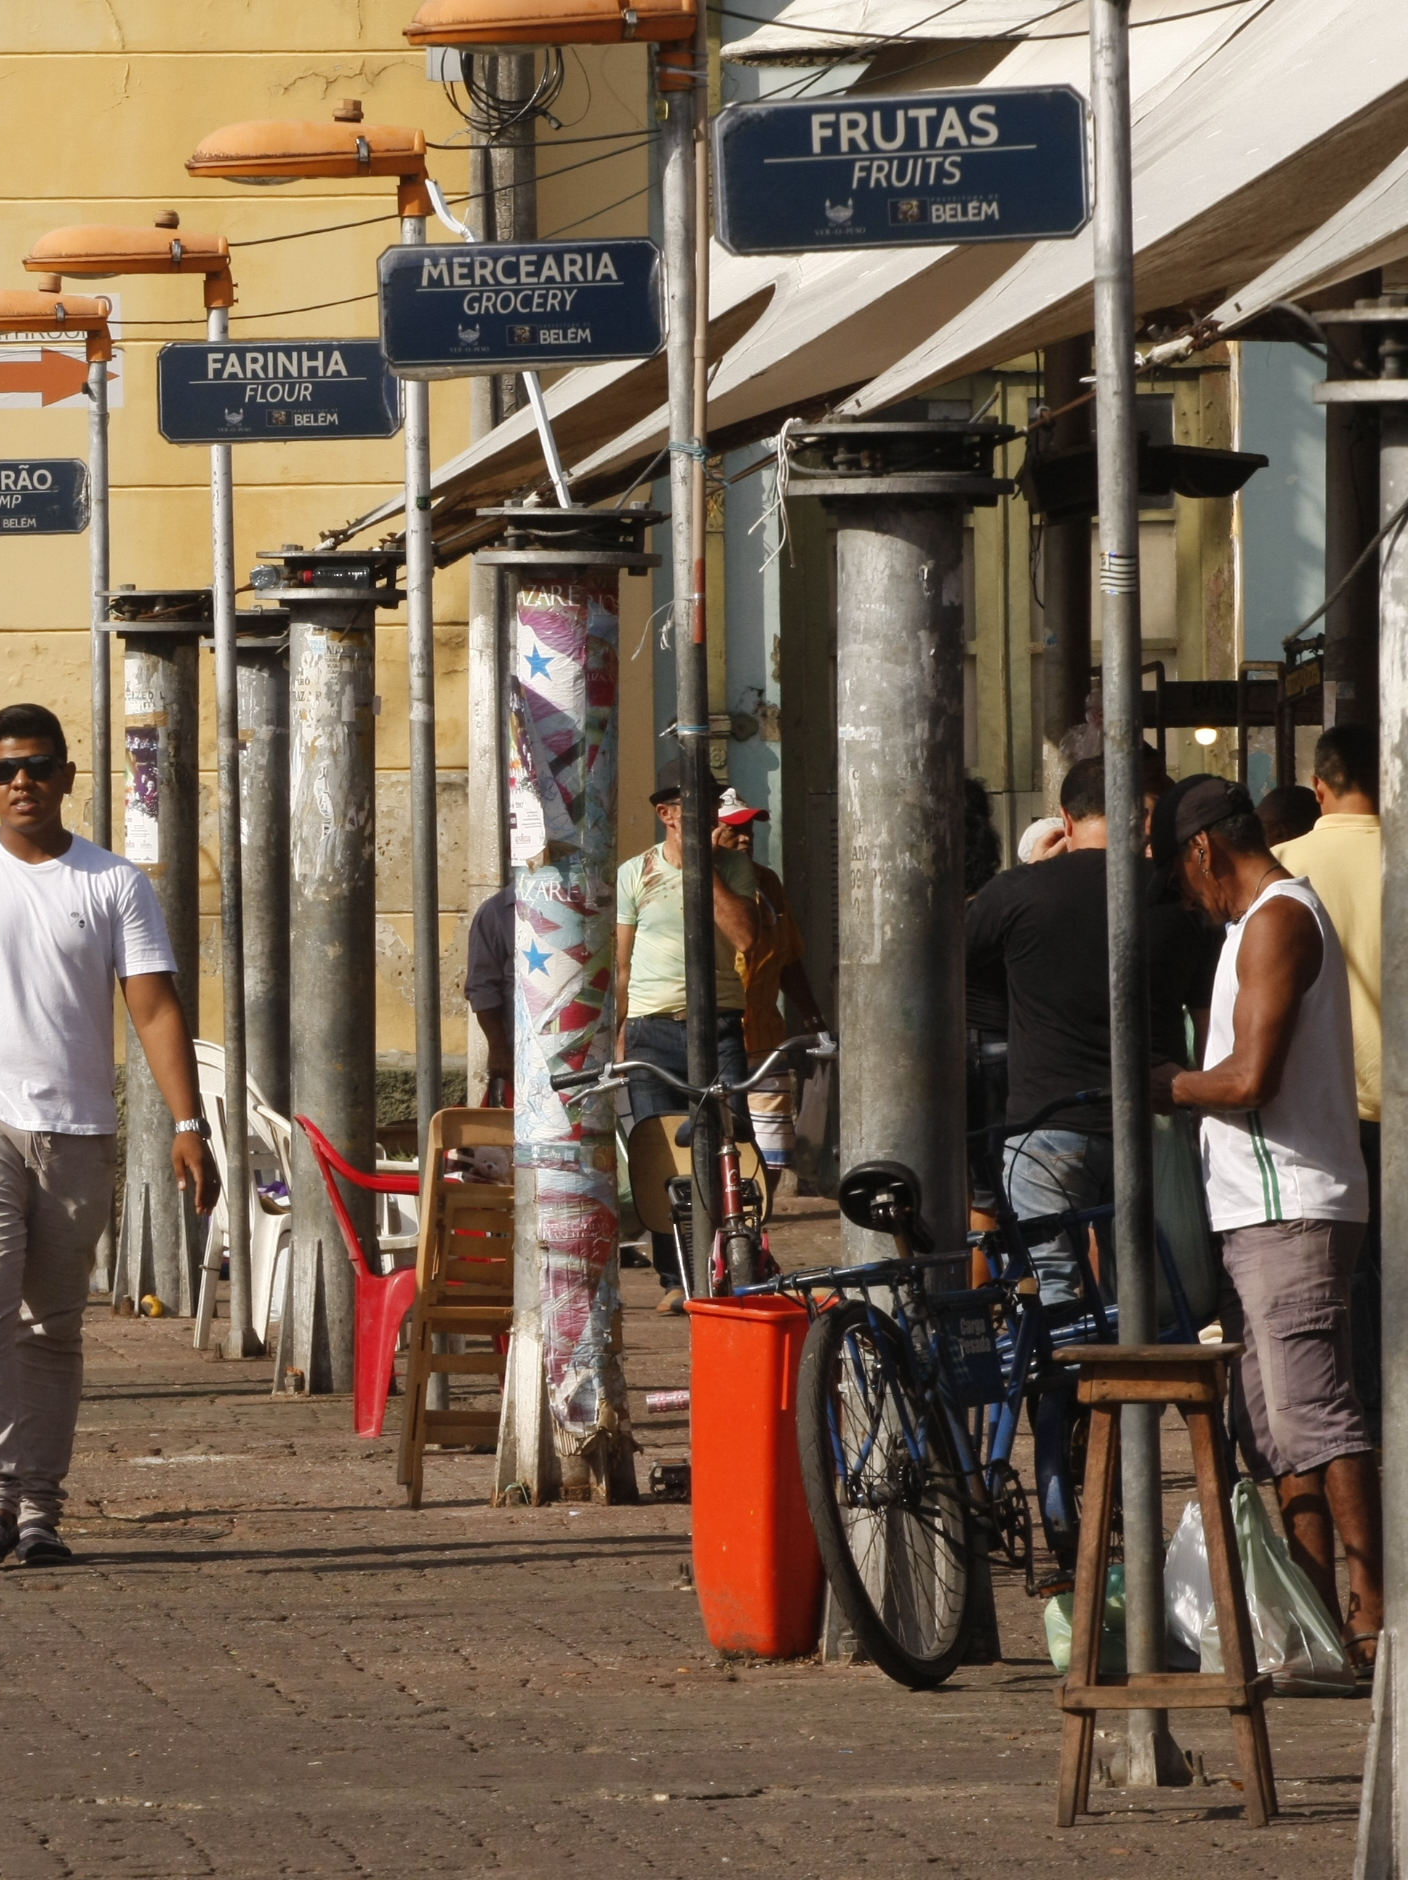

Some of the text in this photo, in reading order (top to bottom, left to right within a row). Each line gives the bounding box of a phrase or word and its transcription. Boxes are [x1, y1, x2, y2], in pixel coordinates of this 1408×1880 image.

[810, 105, 999, 154] FRUTAS
[852, 156, 962, 190] FRUITS
[931, 200, 1000, 224] BELÉM
[421, 252, 618, 287] MERCEARIA
[463, 289, 577, 315] GROCERY
[540, 327, 591, 345] BELÉM
[207, 351, 348, 379] FARINHA
[244, 383, 312, 403] FLOUR
[294, 412, 339, 427] BELÉM
[3, 516, 37, 529] BELÉM
